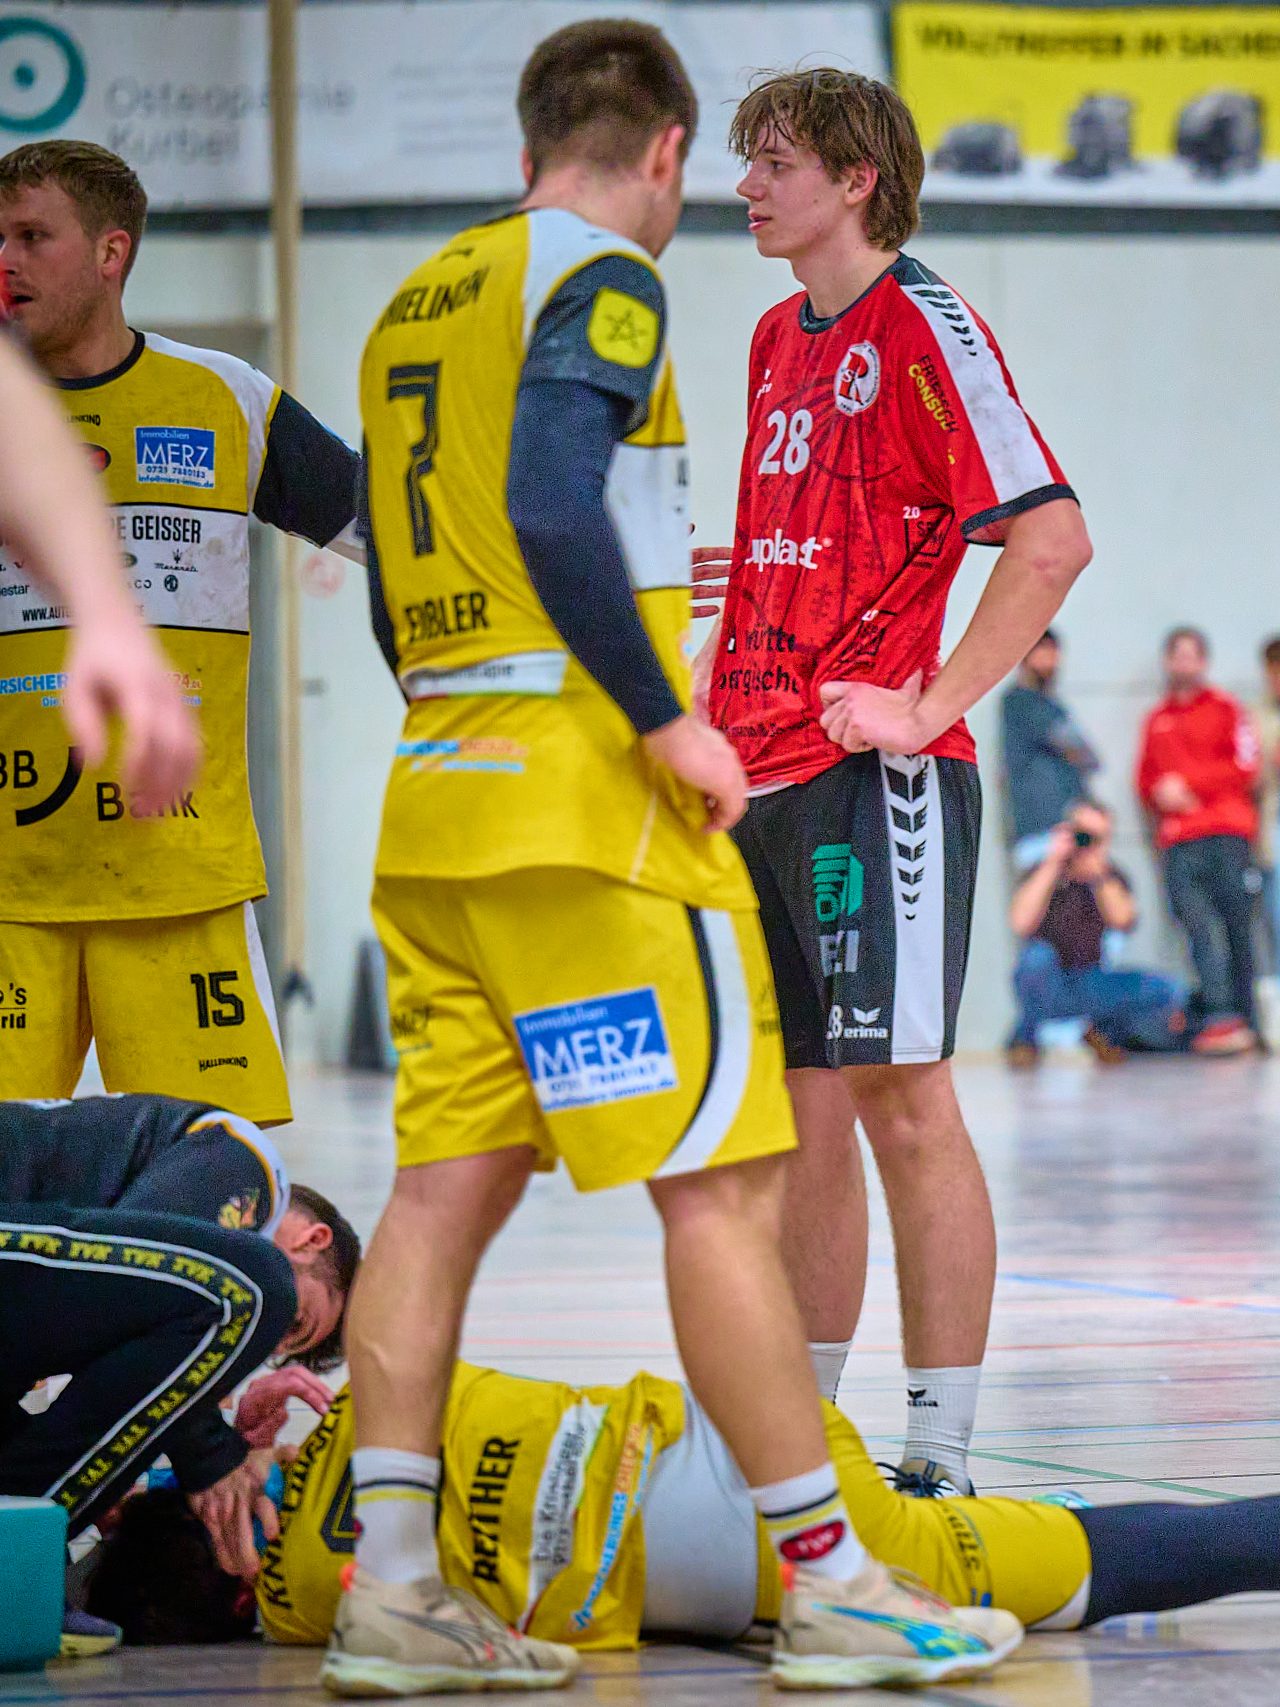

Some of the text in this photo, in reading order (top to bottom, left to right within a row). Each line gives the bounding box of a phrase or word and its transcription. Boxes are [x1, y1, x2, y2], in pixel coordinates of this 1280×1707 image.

[140, 429, 190, 440] Immobilien
[758, 409, 812, 475] 28
[141, 442, 209, 469] MERZ
[131, 515, 201, 543] GEISSER
[190, 970, 246, 1029] 15
[843, 1026, 889, 1039] erima
[198, 1056, 248, 1072] HALLENKIND
[531, 1018, 652, 1083] MERZ
